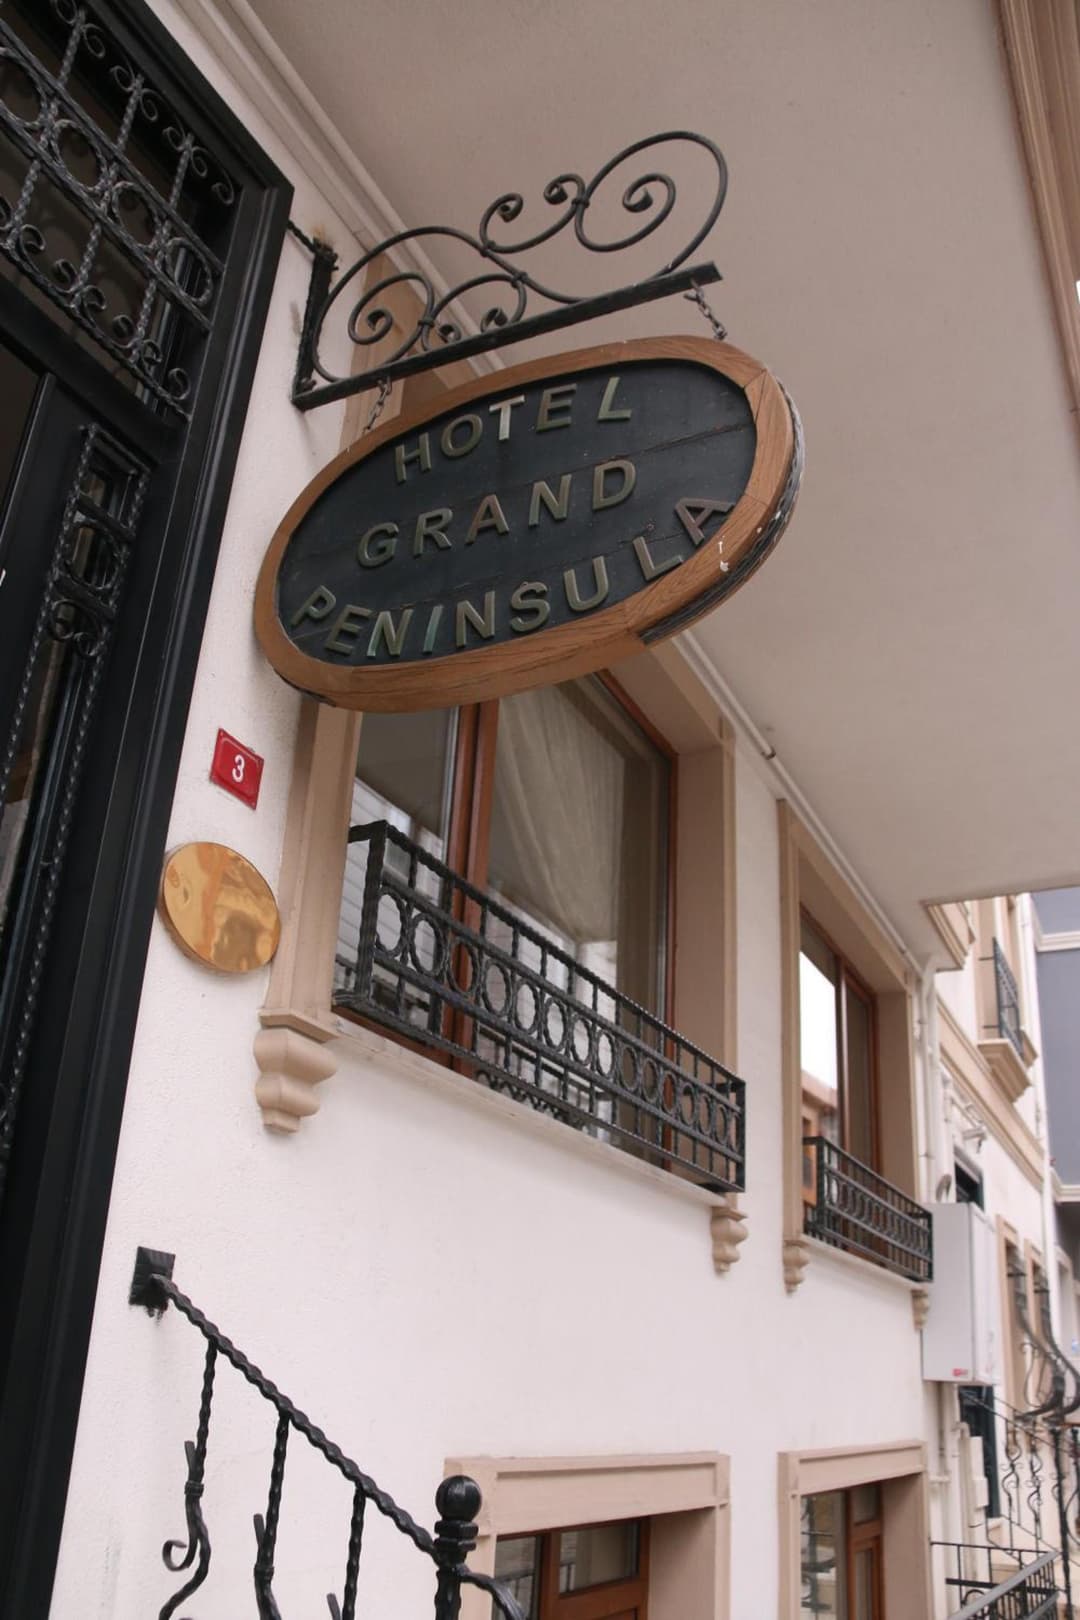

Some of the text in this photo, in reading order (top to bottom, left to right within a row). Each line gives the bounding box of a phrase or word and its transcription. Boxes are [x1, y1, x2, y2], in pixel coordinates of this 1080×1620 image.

[394, 376, 632, 483] HOTEL
[356, 458, 637, 568] GRAND
[290, 497, 735, 657] PENINSULA
[231, 754, 245, 783] 3
